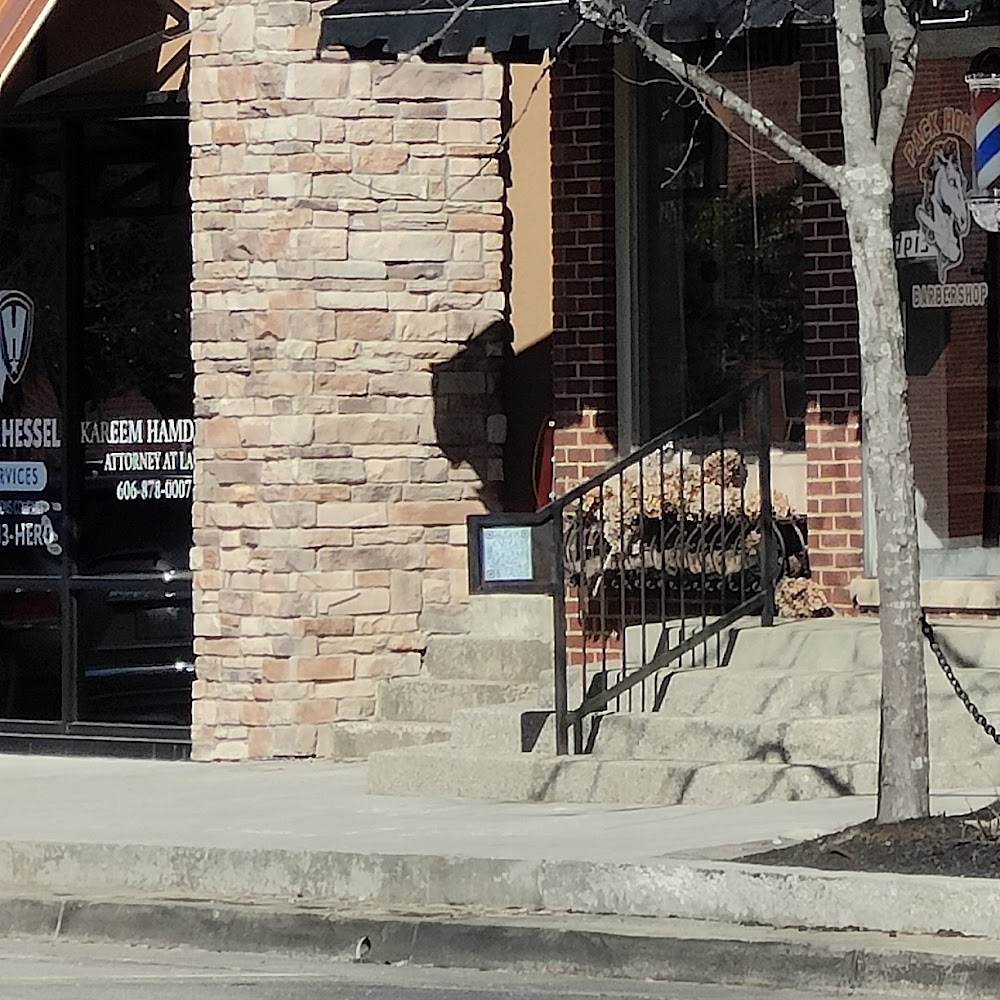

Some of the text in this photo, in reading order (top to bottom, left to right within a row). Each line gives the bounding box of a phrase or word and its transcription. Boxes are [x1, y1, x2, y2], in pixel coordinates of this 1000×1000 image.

[903, 109, 941, 169] PACK
[912, 282, 988, 308] BARBERSHOP
[80, 420, 143, 443] KAREEM
[104, 452, 161, 471] ATTORNEY
[162, 451, 178, 470] AT
